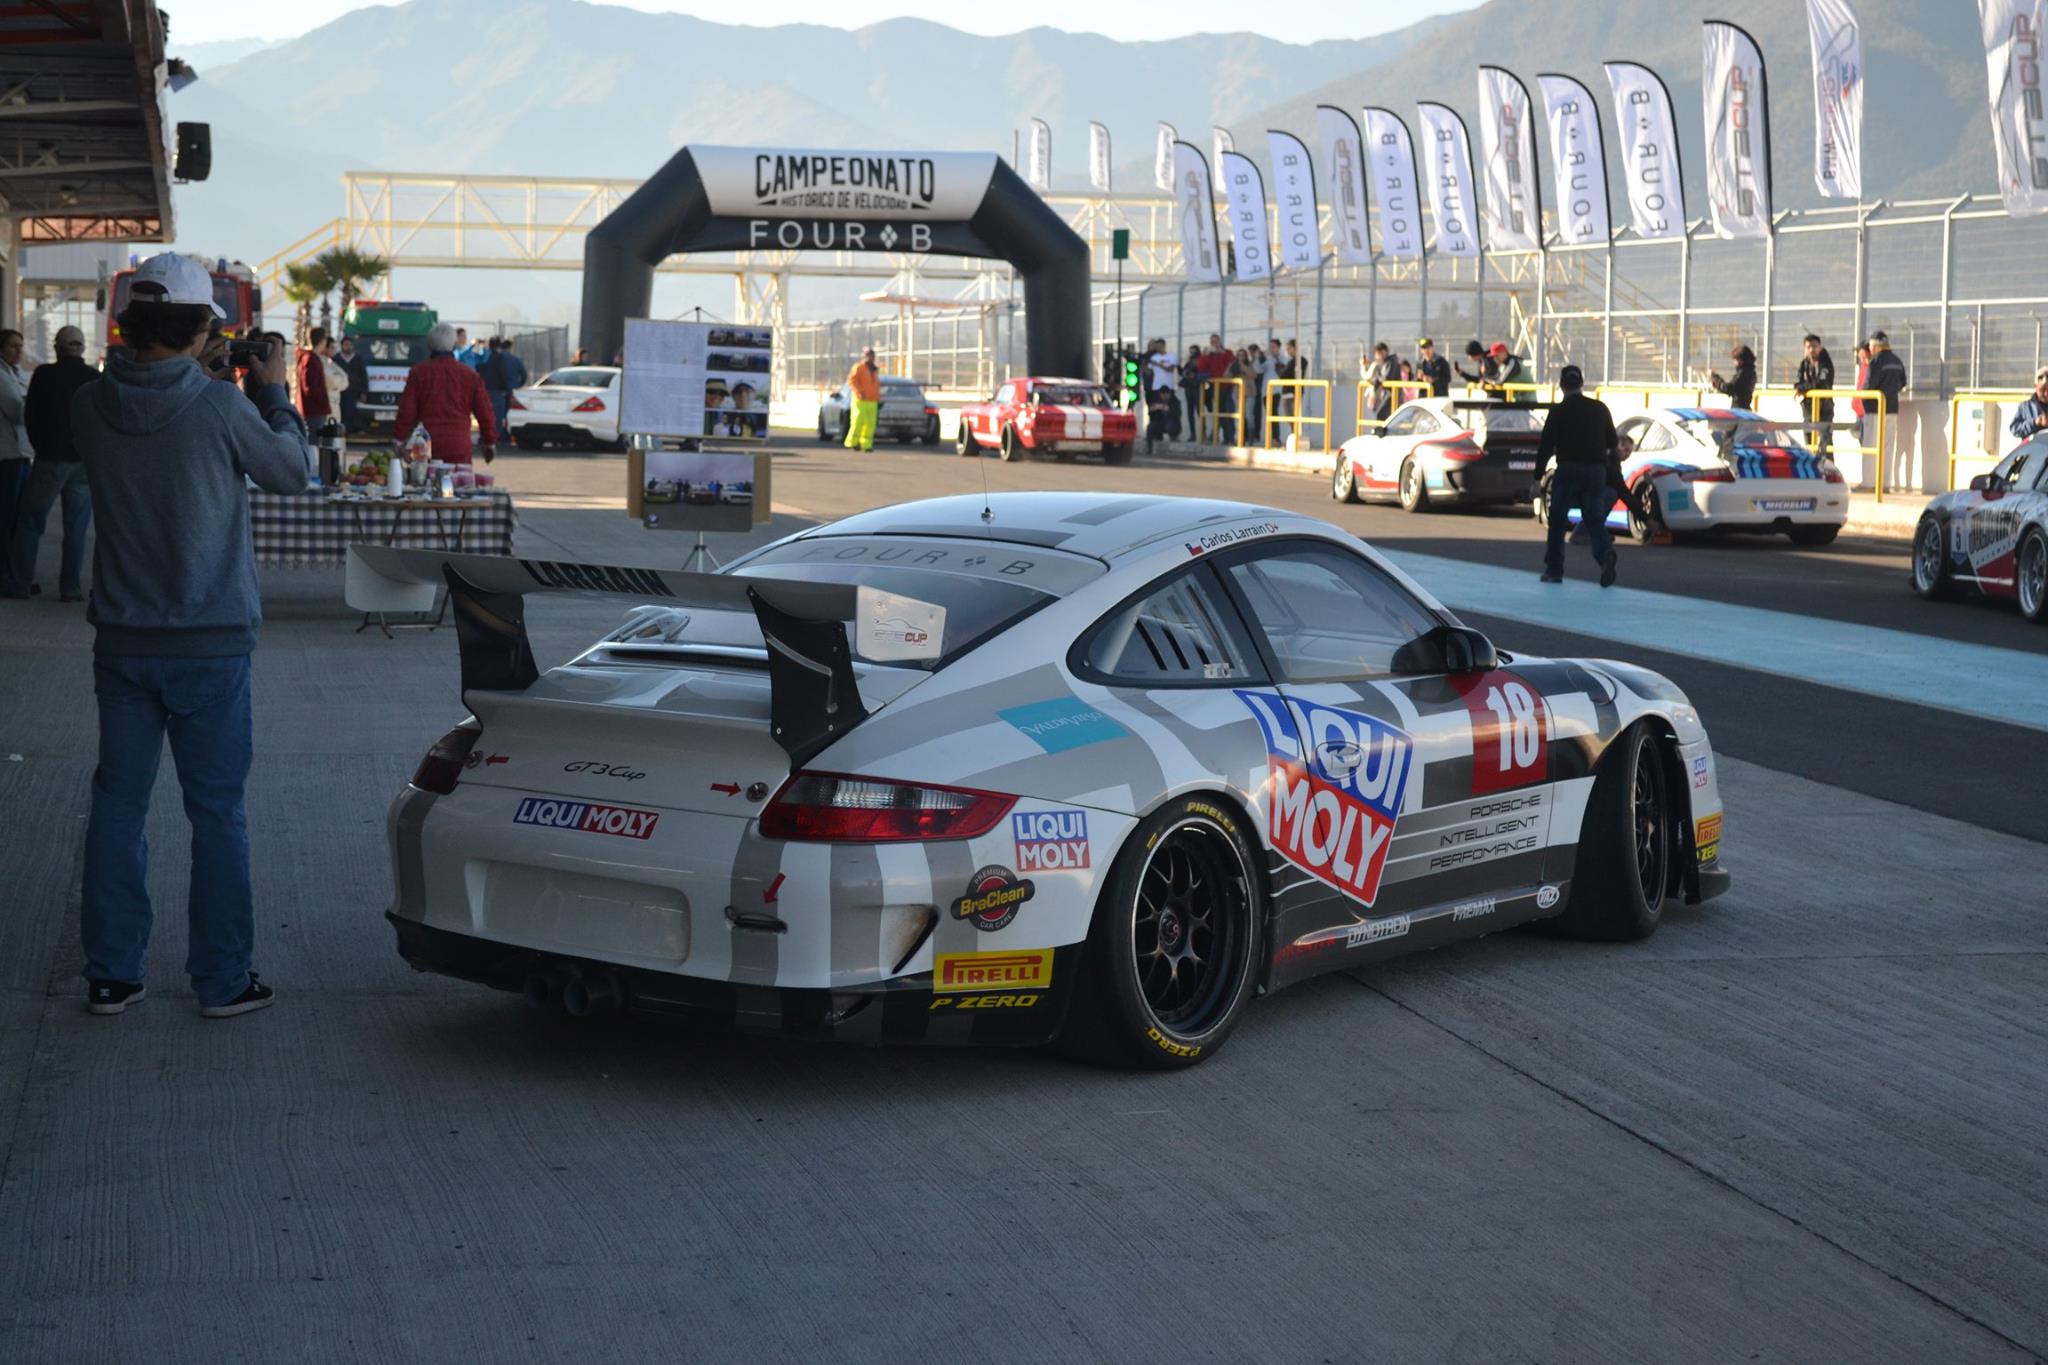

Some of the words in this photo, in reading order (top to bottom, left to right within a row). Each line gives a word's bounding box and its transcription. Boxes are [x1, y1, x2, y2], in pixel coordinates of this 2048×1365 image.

[755, 154, 935, 204] CAMPEONATO
[838, 191, 850, 208] DE
[854, 192, 908, 210] VELOCIDAD
[750, 220, 866, 249] FOUR
[911, 224, 933, 251] B
[1765, 501, 1811, 511] MICHELIN
[1200, 532, 1233, 549] Carlos
[1231, 523, 1267, 540] Larrain
[800, 546, 949, 565] FOUR
[998, 560, 1035, 575] B
[520, 560, 678, 597] LARRAIN
[1485, 681, 1539, 772] 18
[1246, 694, 1407, 811] LIQUI
[517, 800, 585, 828] LIQUI
[583, 806, 657, 837] MOLY
[1186, 801, 1236, 833] PIRELLI
[1470, 794, 1541, 819] PORSCHE
[1016, 813, 1084, 840] LIQUI
[1273, 765, 1391, 890] MOLY
[1440, 815, 1539, 847] INTELLIGENT
[1019, 842, 1087, 869] MOLY
[1430, 836, 1537, 870] PERFOMANCE
[960, 886, 1025, 916] BraClean
[980, 921, 994, 929] CAR
[942, 955, 1043, 985] PIRELLI
[929, 998, 953, 1009] P
[956, 994, 1040, 1009] ZERO
